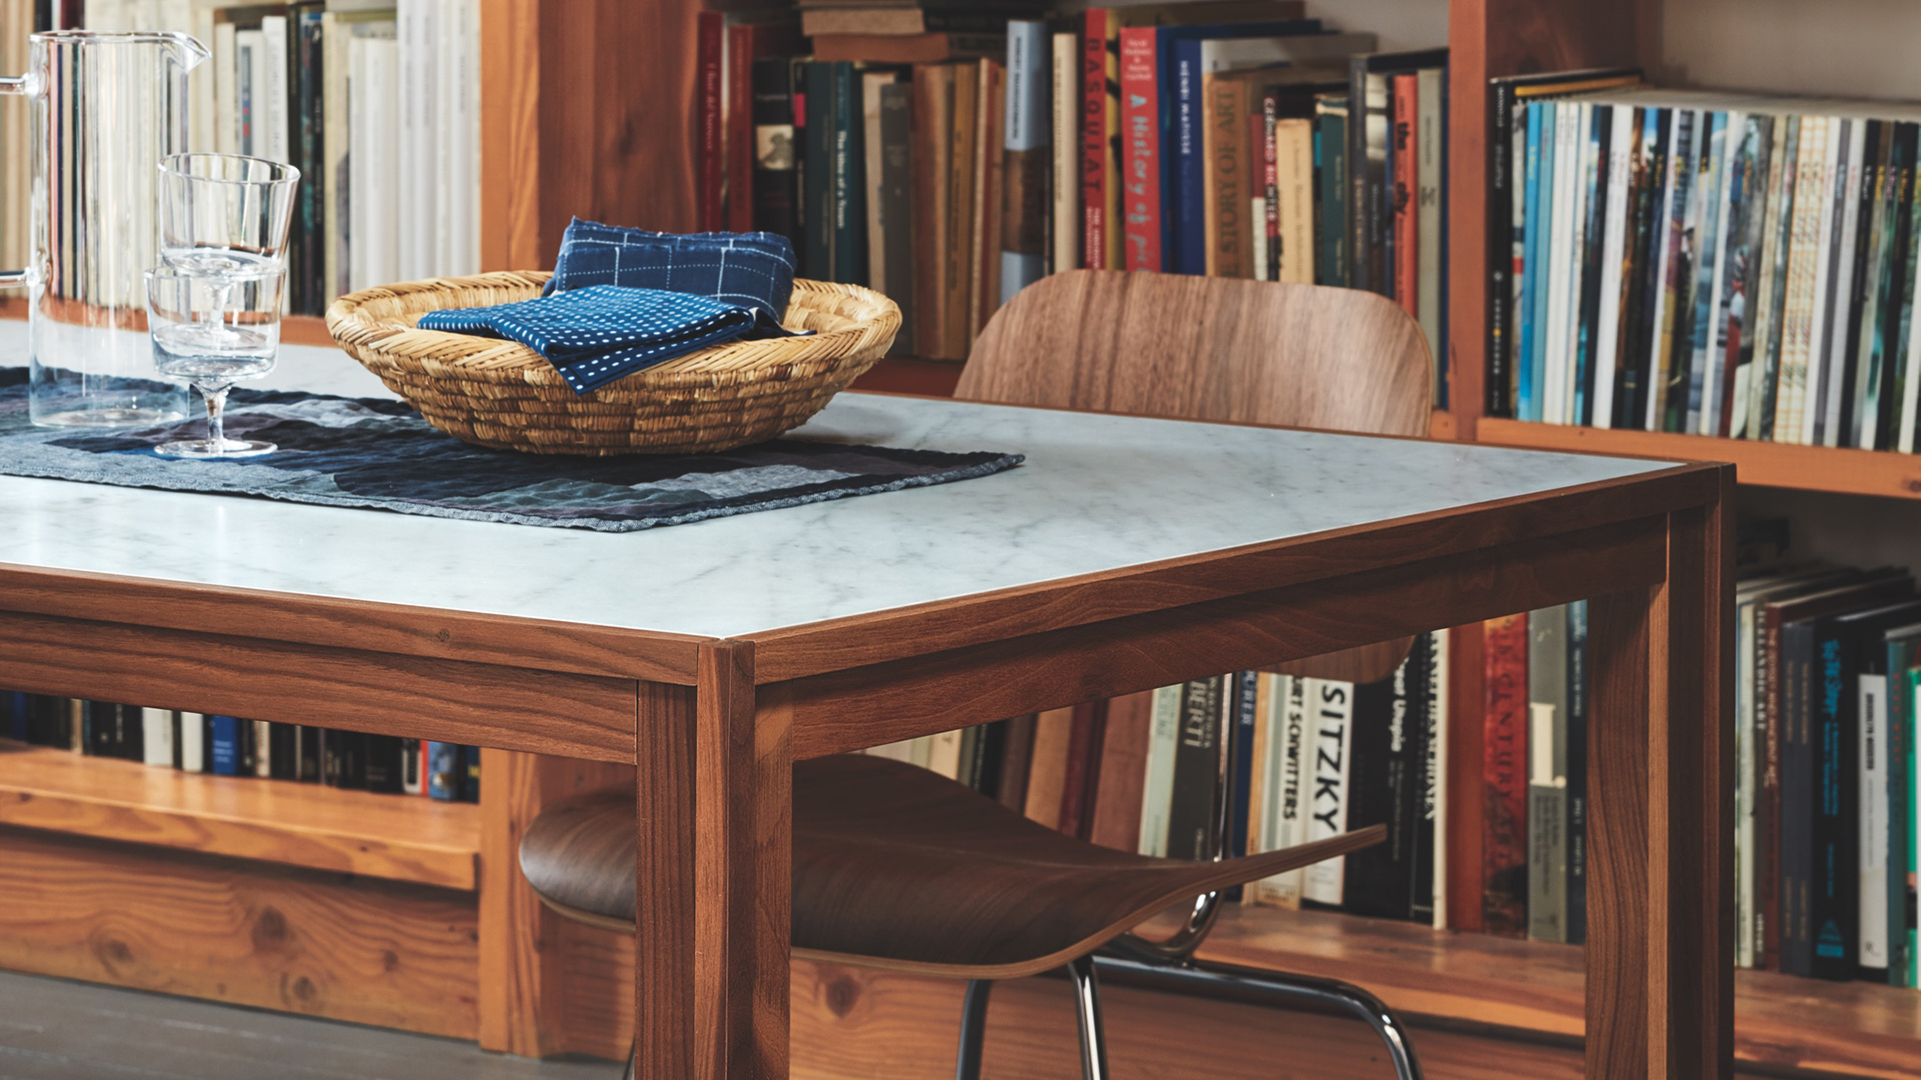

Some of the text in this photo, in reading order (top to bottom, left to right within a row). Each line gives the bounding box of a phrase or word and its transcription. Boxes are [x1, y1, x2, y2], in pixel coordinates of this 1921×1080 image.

[1130, 94, 1147, 108] A
[1180, 60, 1190, 101] HENRI
[1085, 38, 1101, 193] BASQUIAT
[1180, 103, 1190, 156] MATISSE
[1216, 92, 1236, 131] ART
[837, 130, 847, 151] The
[1126, 116, 1151, 195] History
[1396, 122, 1411, 151] the
[837, 152, 847, 175] Idea
[1217, 146, 1237, 173] OF
[1264, 98, 1277, 222] GERHARD RICHTER
[837, 177, 847, 189] of
[1394, 181, 1411, 216] city
[837, 199, 847, 229] Town
[1128, 202, 1150, 225] of
[1219, 180, 1238, 253] STORY
[1768, 628, 1777, 647] THE
[1756, 611, 1766, 731] ICELANDIC ART
[1183, 680, 1208, 748] BERTI
[1768, 691, 1777, 715] AND
[1389, 699, 1407, 752] Utopia
[1497, 673, 1514, 800] CENTURY
[1768, 717, 1777, 762] ANCIENT
[1283, 713, 1303, 820] SCHWITTERS
[1314, 684, 1346, 832] SITZKY
[1497, 818, 1512, 862] ART
